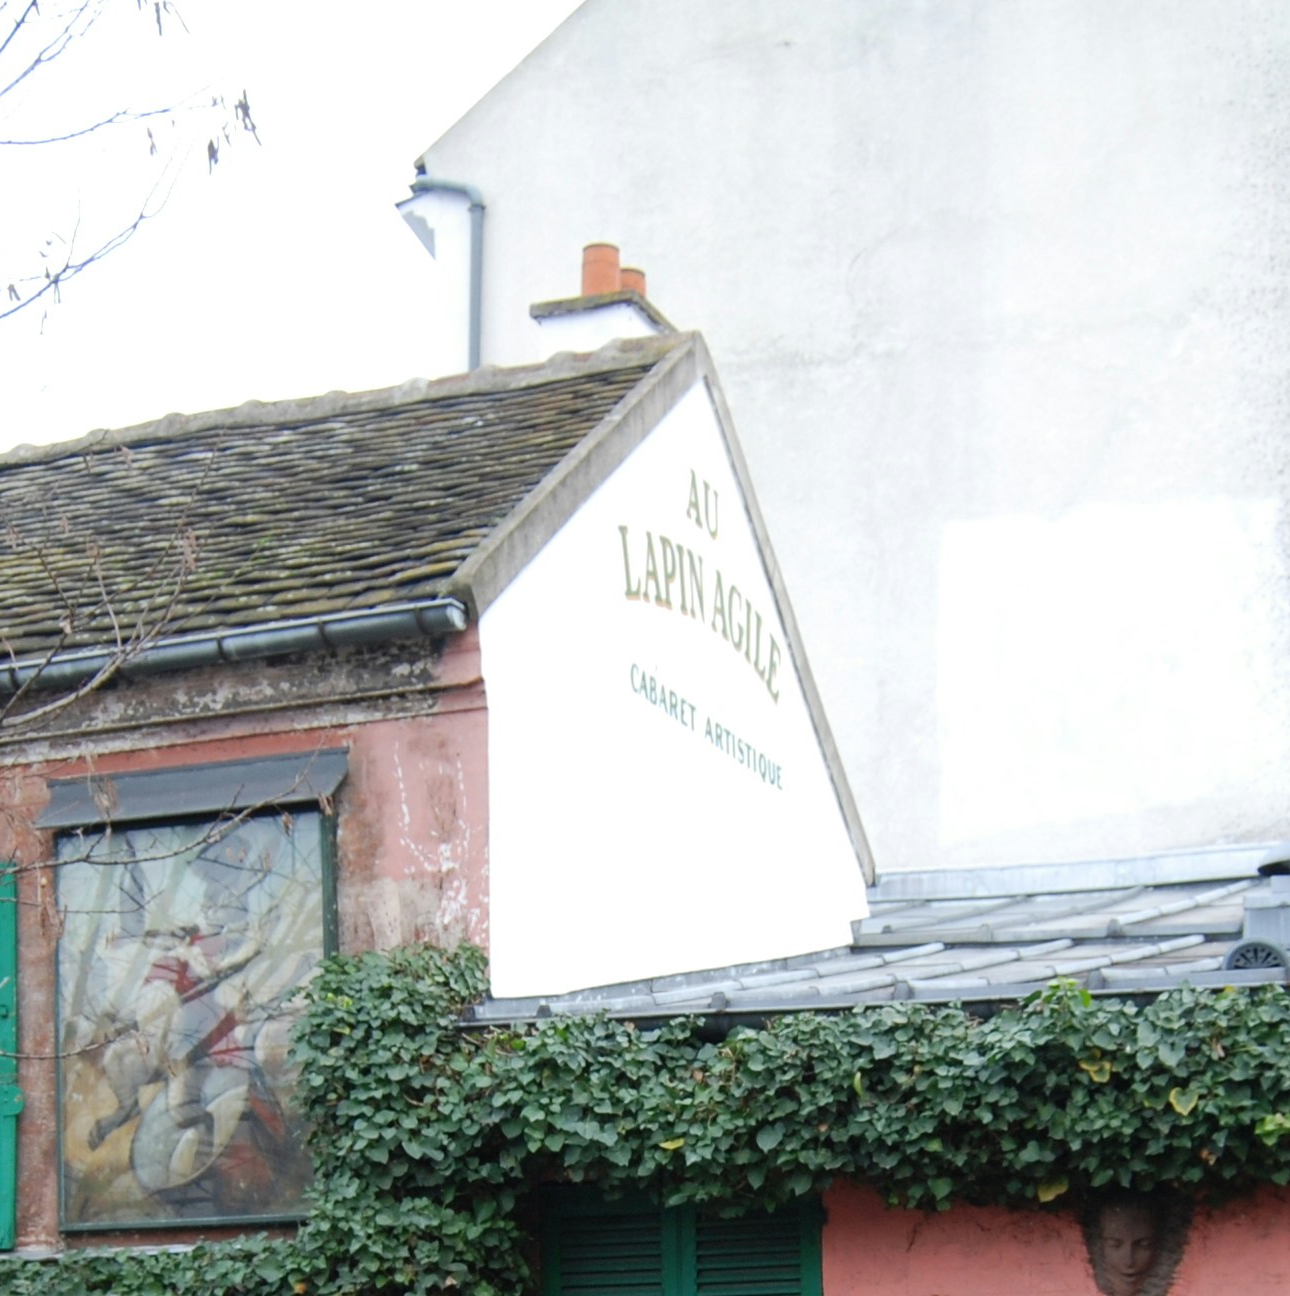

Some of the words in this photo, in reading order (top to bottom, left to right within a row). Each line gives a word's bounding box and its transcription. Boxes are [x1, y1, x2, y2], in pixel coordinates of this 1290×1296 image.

[686, 468, 719, 541] AU
[618, 525, 706, 625] LAPIN
[711, 569, 782, 706] AGILE
[630, 663, 697, 732] CABARET
[705, 716, 784, 791] ARTISTIQUE
